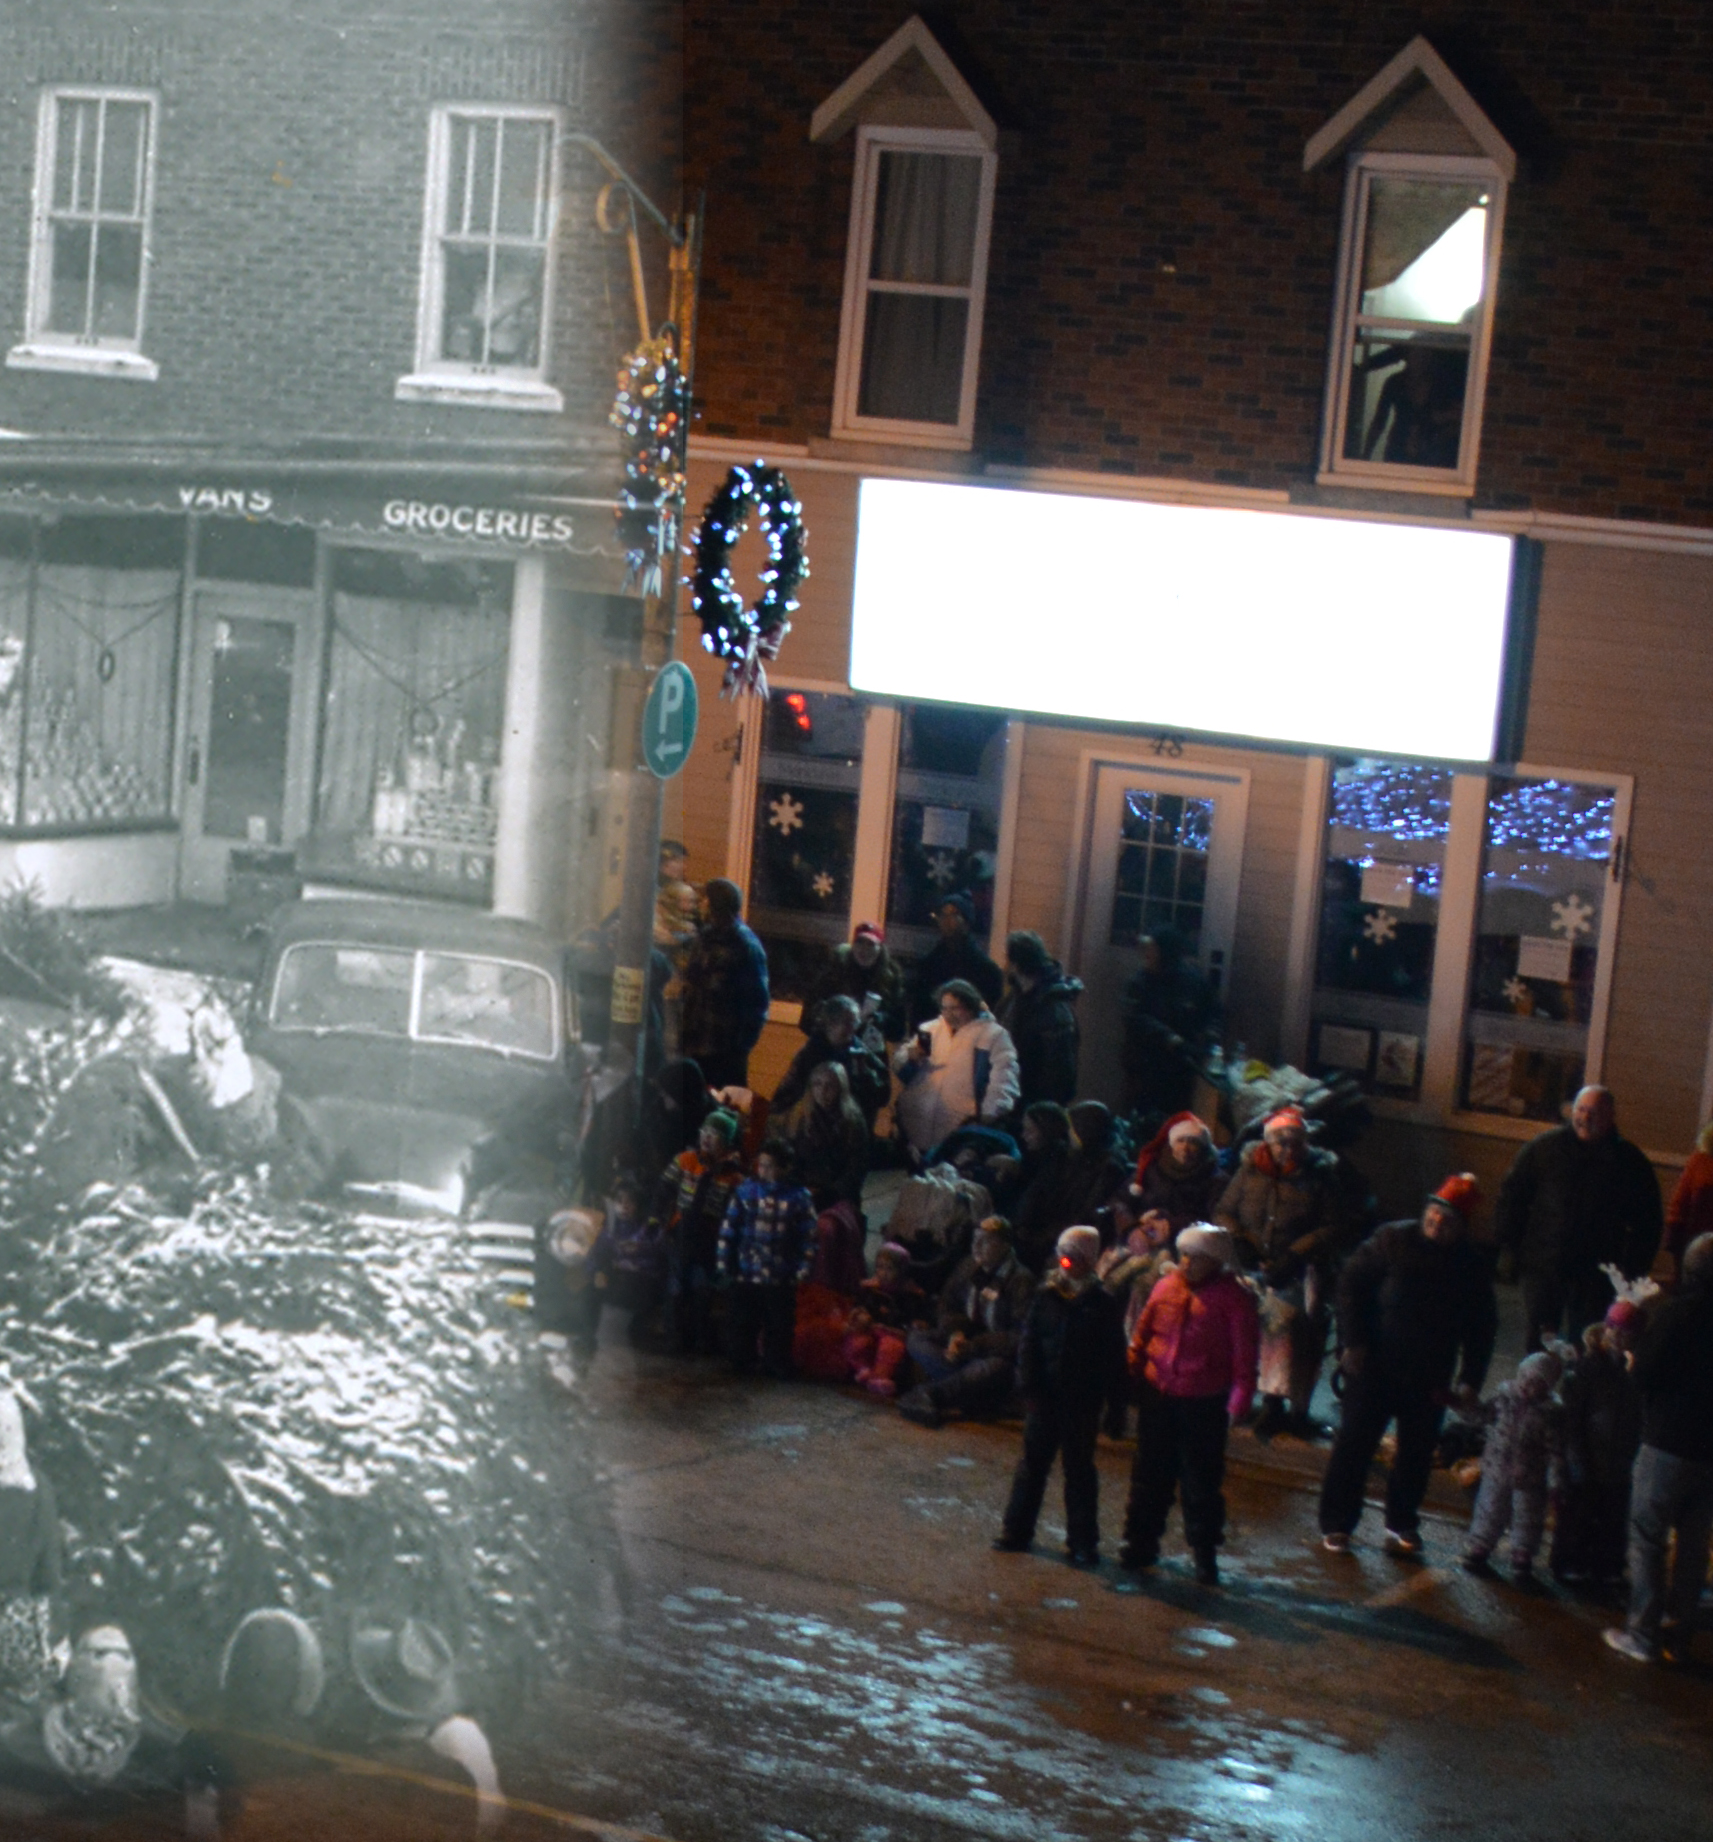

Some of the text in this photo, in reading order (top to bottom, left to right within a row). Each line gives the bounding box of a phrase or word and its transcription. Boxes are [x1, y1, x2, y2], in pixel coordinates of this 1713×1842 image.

[178, 486, 272, 513] VANS
[382, 499, 574, 541] GROCERIES
[658, 670, 685, 735] P
[1150, 731, 1184, 759] 48
